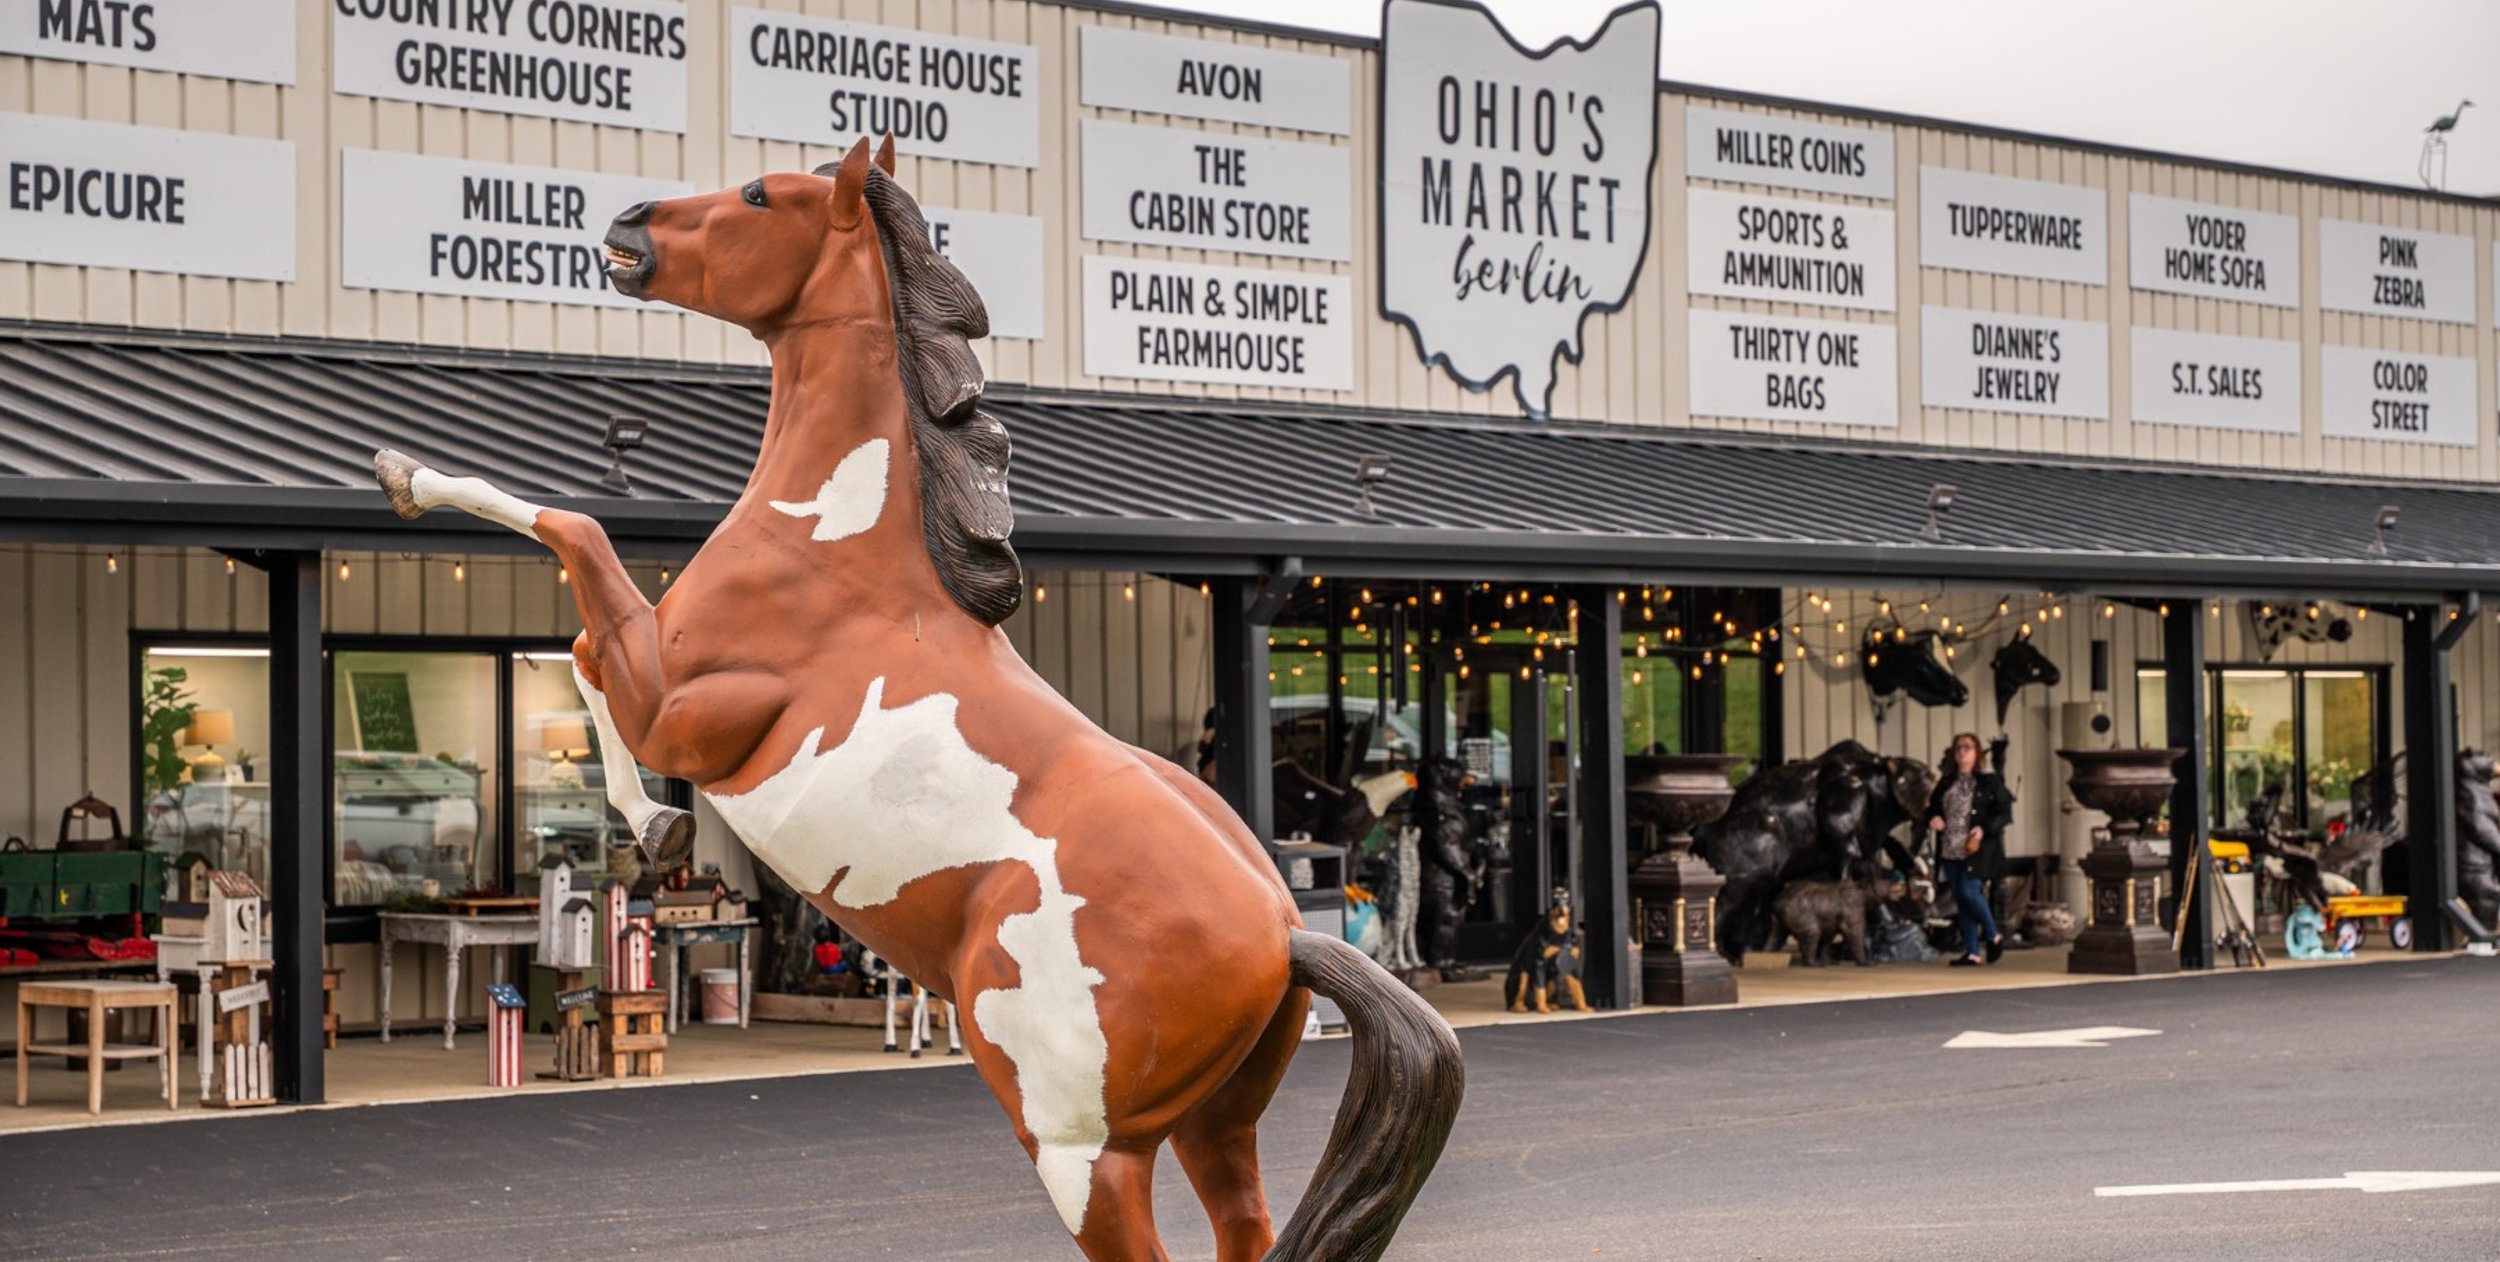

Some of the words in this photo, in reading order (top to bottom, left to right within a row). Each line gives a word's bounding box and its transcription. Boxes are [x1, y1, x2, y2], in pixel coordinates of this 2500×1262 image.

[39, 0, 156, 52] MATS
[527, 0, 687, 60] CORNERS
[395, 40, 632, 111] GREENHOUSE
[750, 23, 910, 84] CARRIAGE
[920, 46, 1021, 98] HOUSE
[1177, 59, 1262, 103] AVON
[830, 90, 948, 143] STUDIO
[1438, 75, 1604, 163] OHIO'S
[1194, 145, 1246, 188] THE
[1717, 128, 1794, 170] MILLER
[1800, 137, 1866, 177] COINS
[10, 162, 185, 225] EPICURE
[463, 176, 585, 230] MILLER
[1129, 190, 1215, 236] CABIN
[1224, 199, 1310, 245] STORE
[1421, 156, 1620, 243] MARKET
[1738, 205, 1824, 248] SPORTS
[1831, 216, 1848, 250] &
[1947, 203, 2082, 251] TUPPERWARE
[2186, 214, 2247, 252] YODER
[430, 233, 609, 290] FORESTRY
[1453, 233, 1592, 304] berlin
[1723, 250, 1864, 297] AMMUNITION
[2165, 247, 2215, 284] HOME
[2220, 258, 2266, 291] SOFA
[2379, 235, 2418, 269] PINK
[1111, 270, 1194, 315] PLAIN
[1203, 278, 1226, 317] &
[1234, 280, 1328, 325] SIMPLE
[2373, 274, 2425, 308] ZEBRA
[1138, 325, 1304, 374] FARMHOUSE
[1729, 324, 1810, 364] THIRTY
[1817, 332, 1859, 368] ONE
[1973, 323, 2061, 363] DIANNE'S
[1766, 373, 1826, 411] BAGS
[1973, 366, 2060, 404] JEWELRY
[2172, 362, 2203, 395] S.T.
[2208, 365, 2262, 400] SALES
[2373, 360, 2428, 393] COLOR
[2372, 399, 2430, 432] STREET
